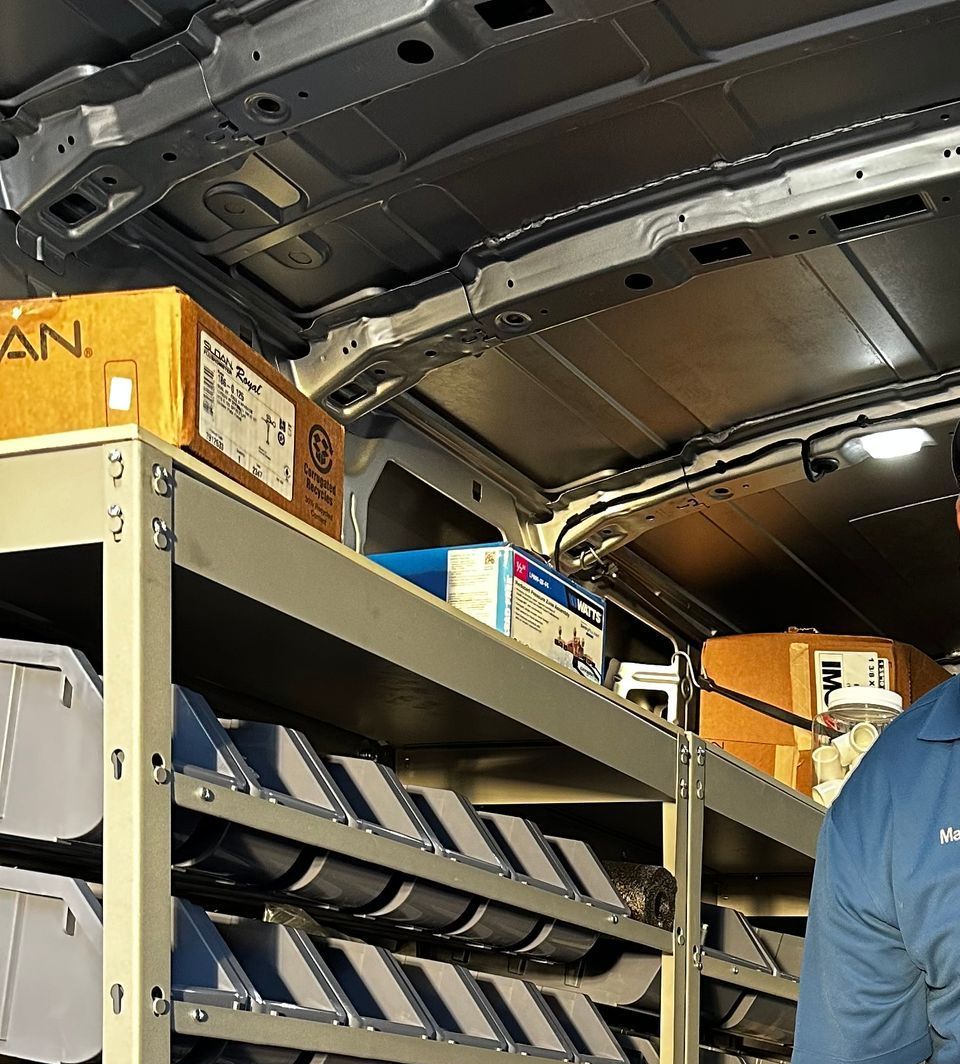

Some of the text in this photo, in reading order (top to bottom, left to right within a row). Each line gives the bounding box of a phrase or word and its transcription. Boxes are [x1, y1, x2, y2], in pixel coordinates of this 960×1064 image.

[236, 366, 262, 395] Royal
[303, 463, 336, 496] Corrugated
[306, 477, 333, 506] Recycles
[577, 599, 602, 623] WATTS
